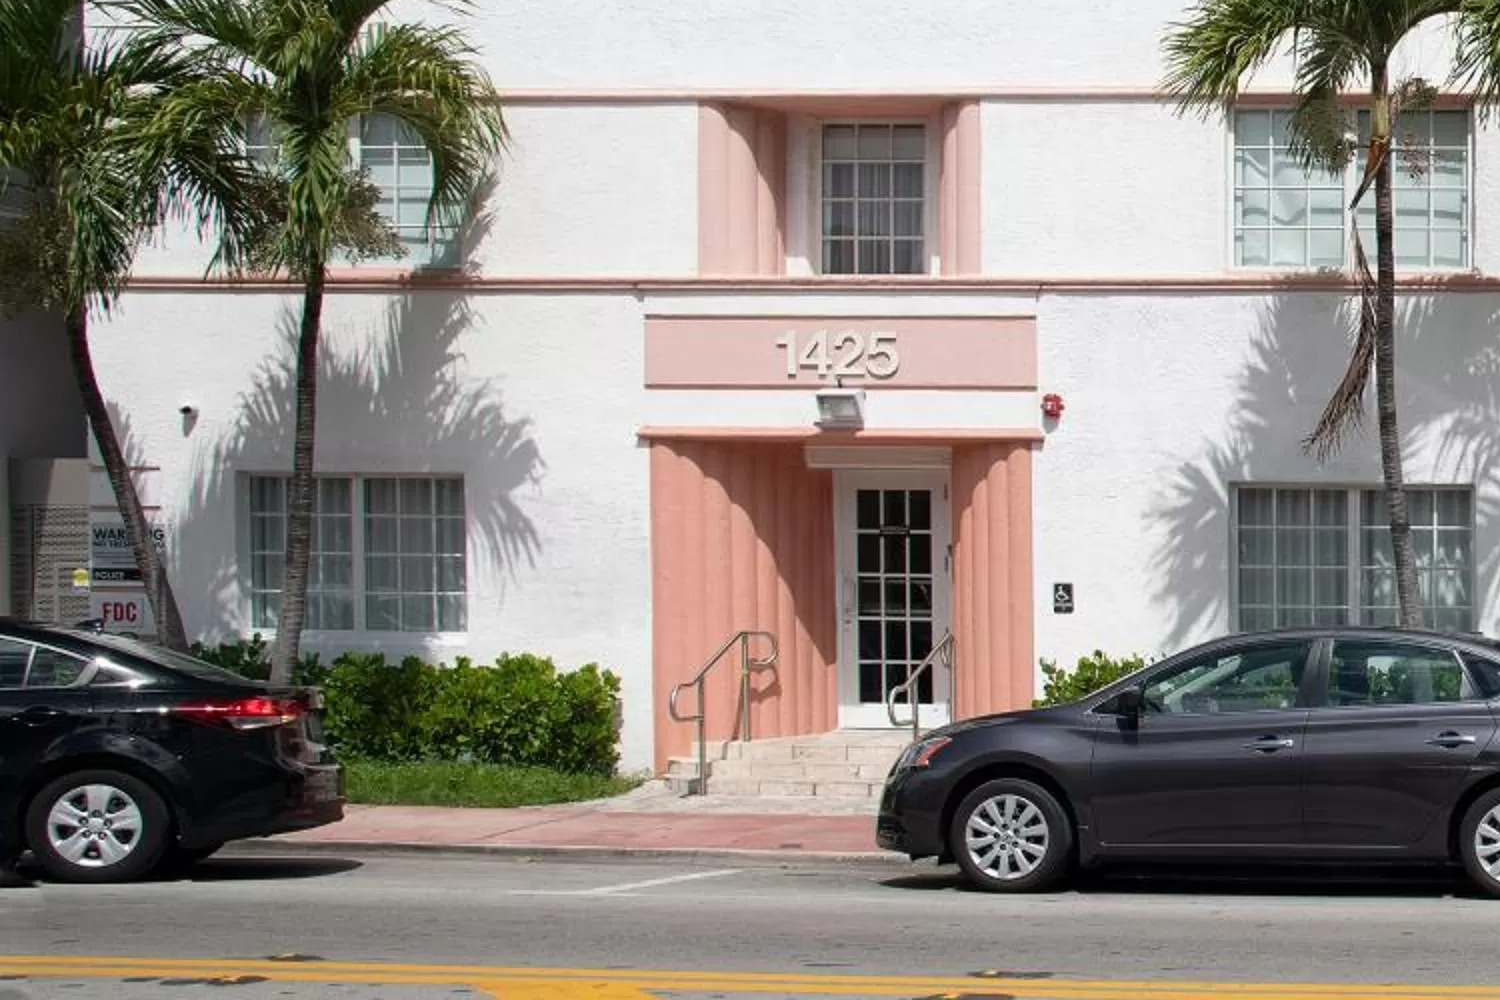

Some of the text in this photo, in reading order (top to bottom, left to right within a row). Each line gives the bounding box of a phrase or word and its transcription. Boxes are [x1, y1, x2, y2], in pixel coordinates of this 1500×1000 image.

[776, 329, 899, 379] 1425
[92, 527, 165, 540] WARG
[102, 602, 137, 622] FDC
